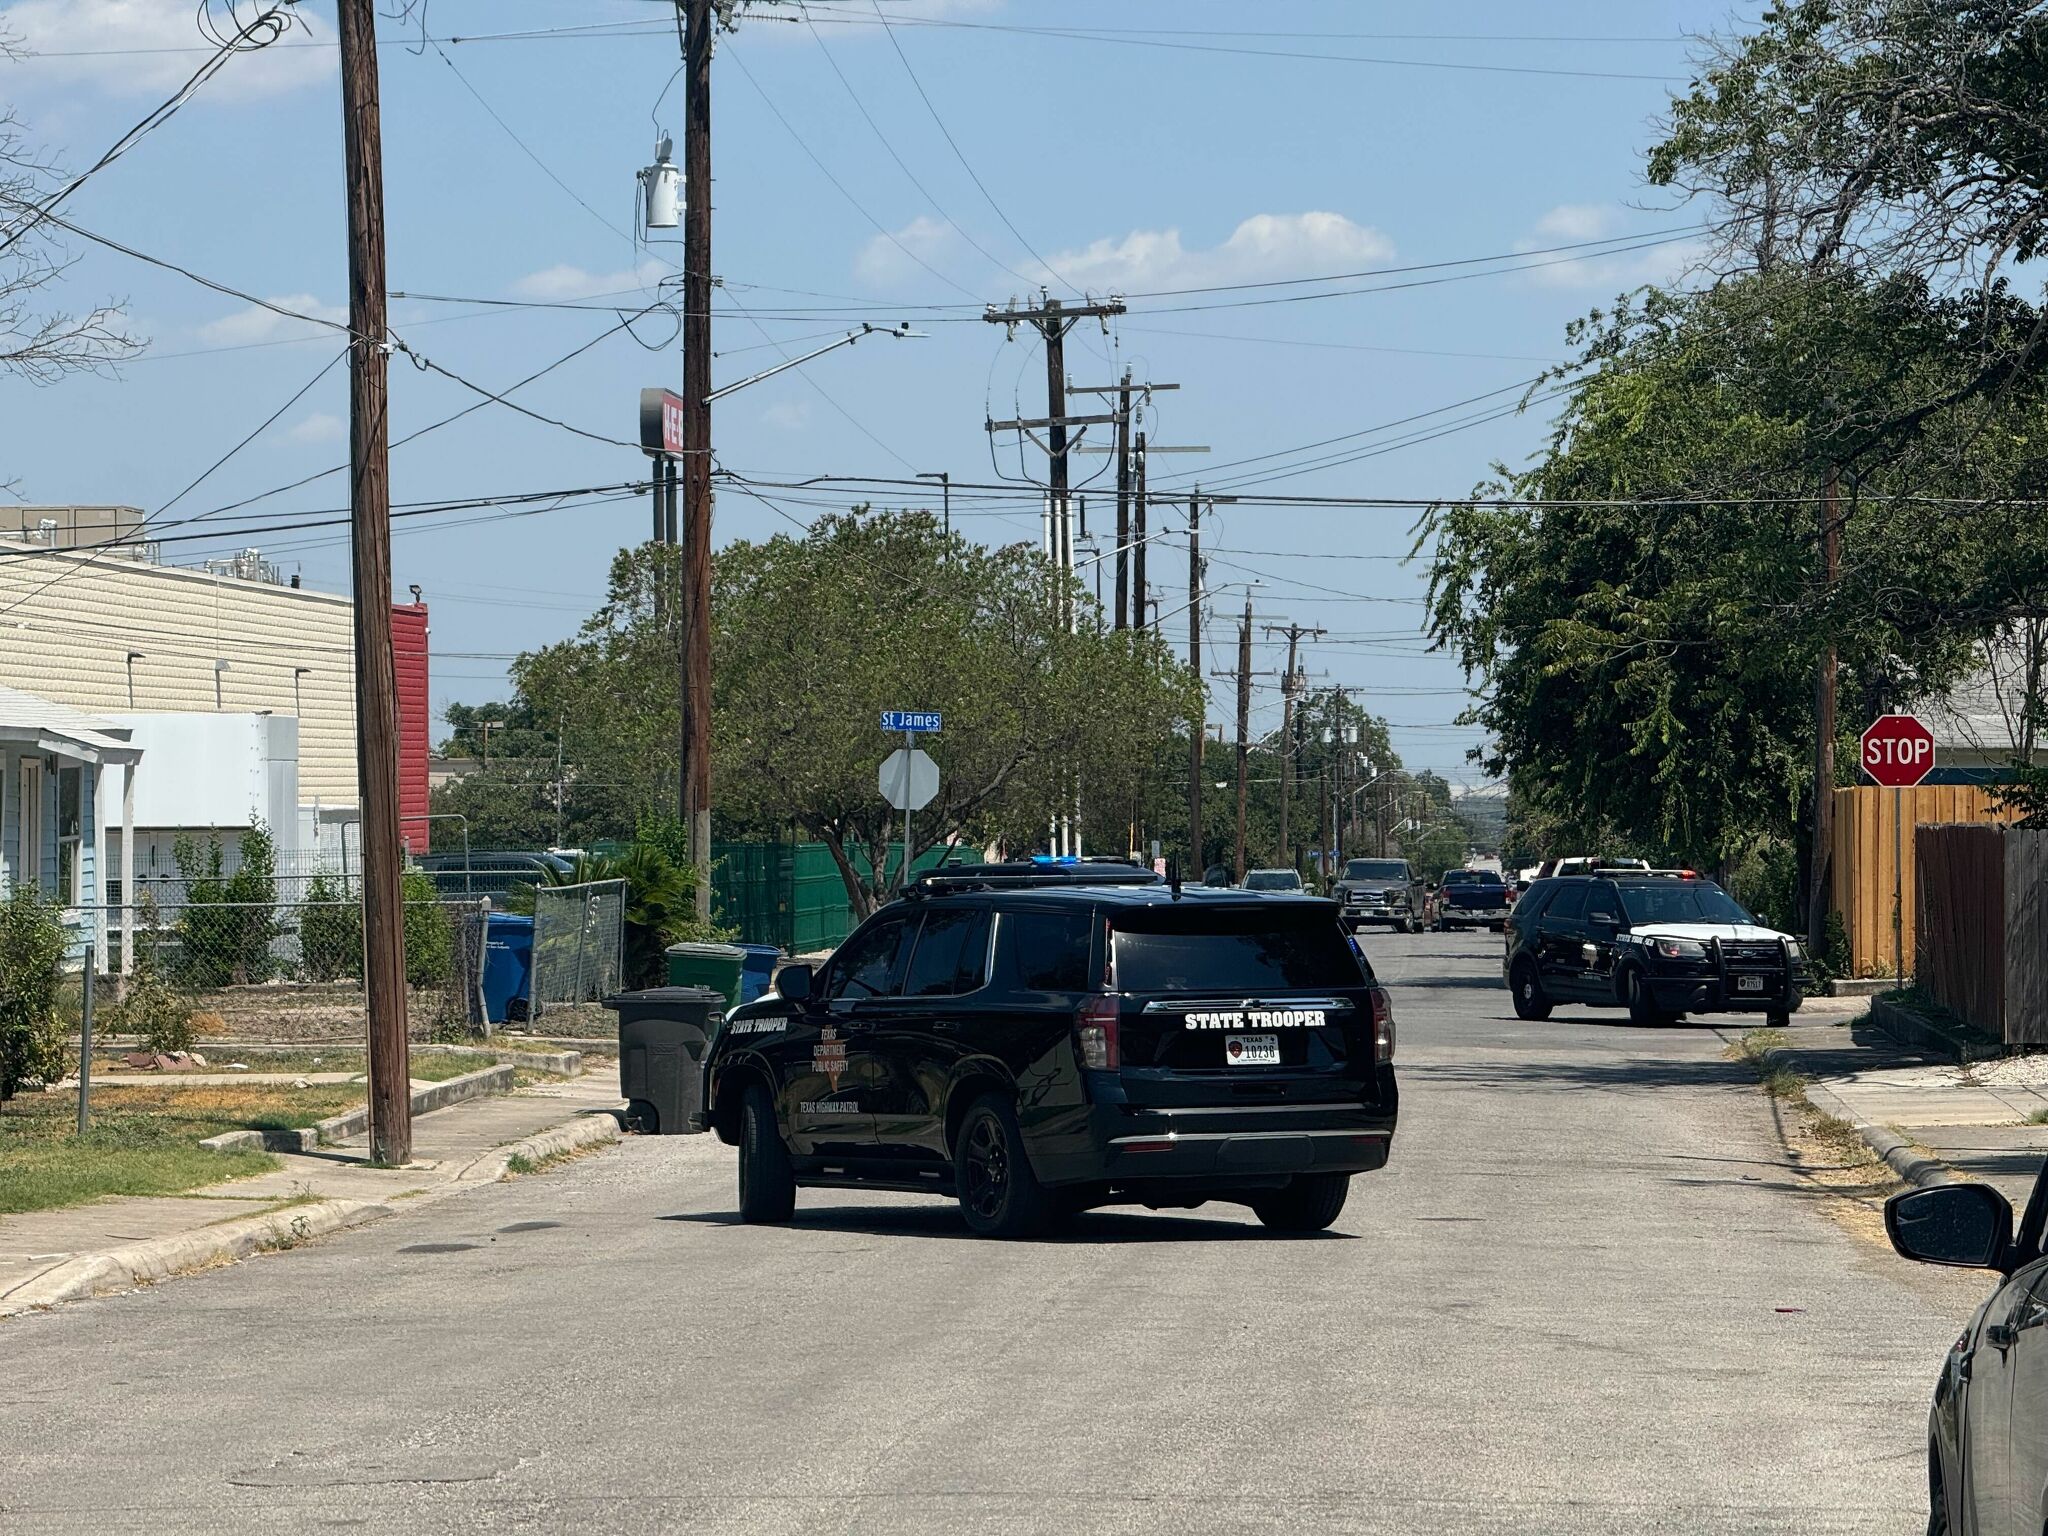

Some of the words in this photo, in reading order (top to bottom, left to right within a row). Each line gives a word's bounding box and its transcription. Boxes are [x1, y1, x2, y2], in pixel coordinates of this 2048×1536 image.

[882, 712, 895, 726] St
[899, 712, 939, 727] James
[1866, 738, 1930, 765] STOP
[730, 1019, 755, 1035] STATE
[754, 1017, 788, 1032] TROOPER
[1185, 1012, 1244, 1030] STATE
[1247, 1010, 1326, 1028] TROOPER
[821, 1028, 837, 1040] TEXAS
[813, 1044, 846, 1056] DEPARTMENT
[1245, 1045, 1275, 1059] 10236
[811, 1060, 830, 1073] PUBLIC
[830, 1060, 849, 1072] SAFETY
[800, 1101, 816, 1114] TEXAS
[816, 1101, 839, 1114] HIGHWAY
[839, 1101, 860, 1114] PATROL
